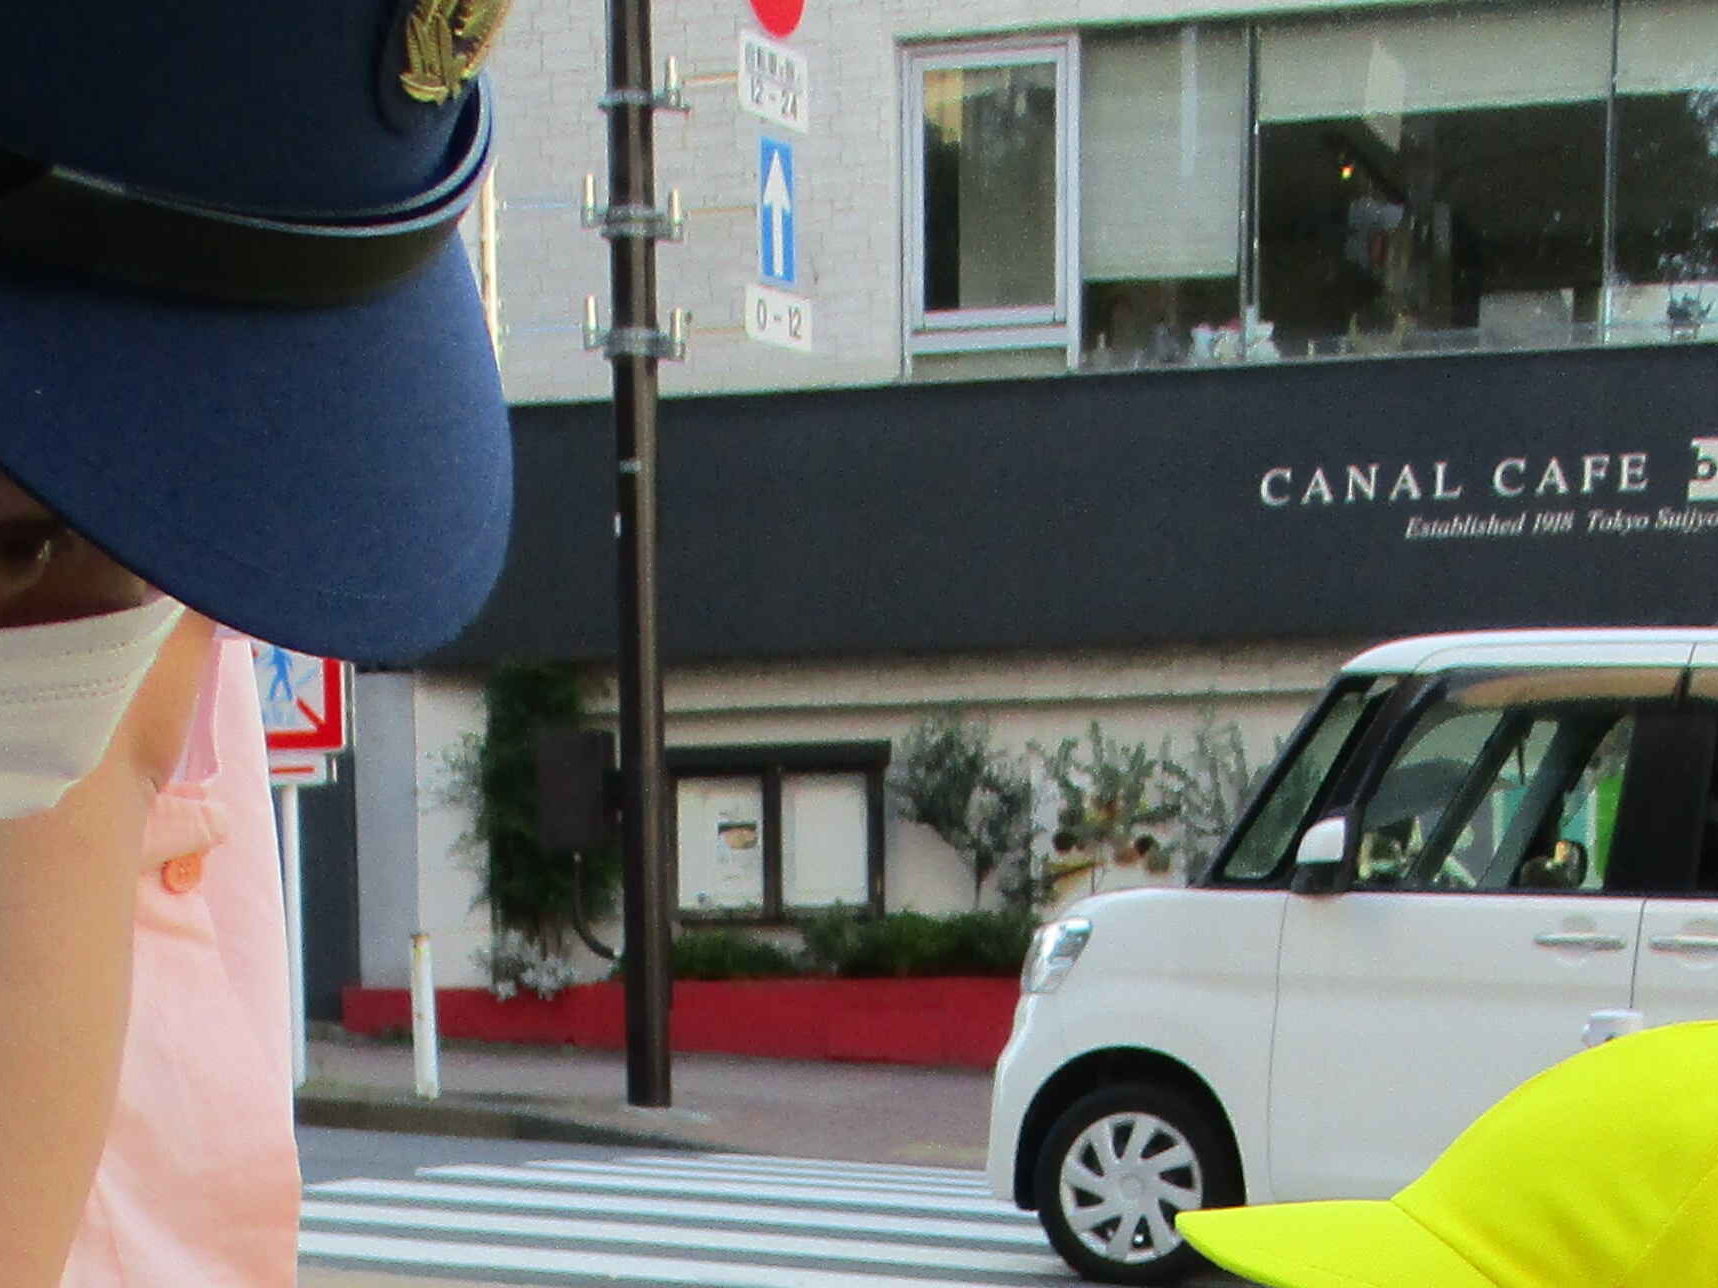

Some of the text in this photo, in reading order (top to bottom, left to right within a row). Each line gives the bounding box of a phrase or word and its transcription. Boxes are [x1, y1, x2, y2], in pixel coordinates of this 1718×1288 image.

[1260, 460, 1463, 507] CANAL
[1492, 451, 1649, 498] CAFE
[1404, 512, 1527, 540] Established
[1532, 509, 1575, 534] 1918
[1586, 507, 1650, 534] Tokyo
